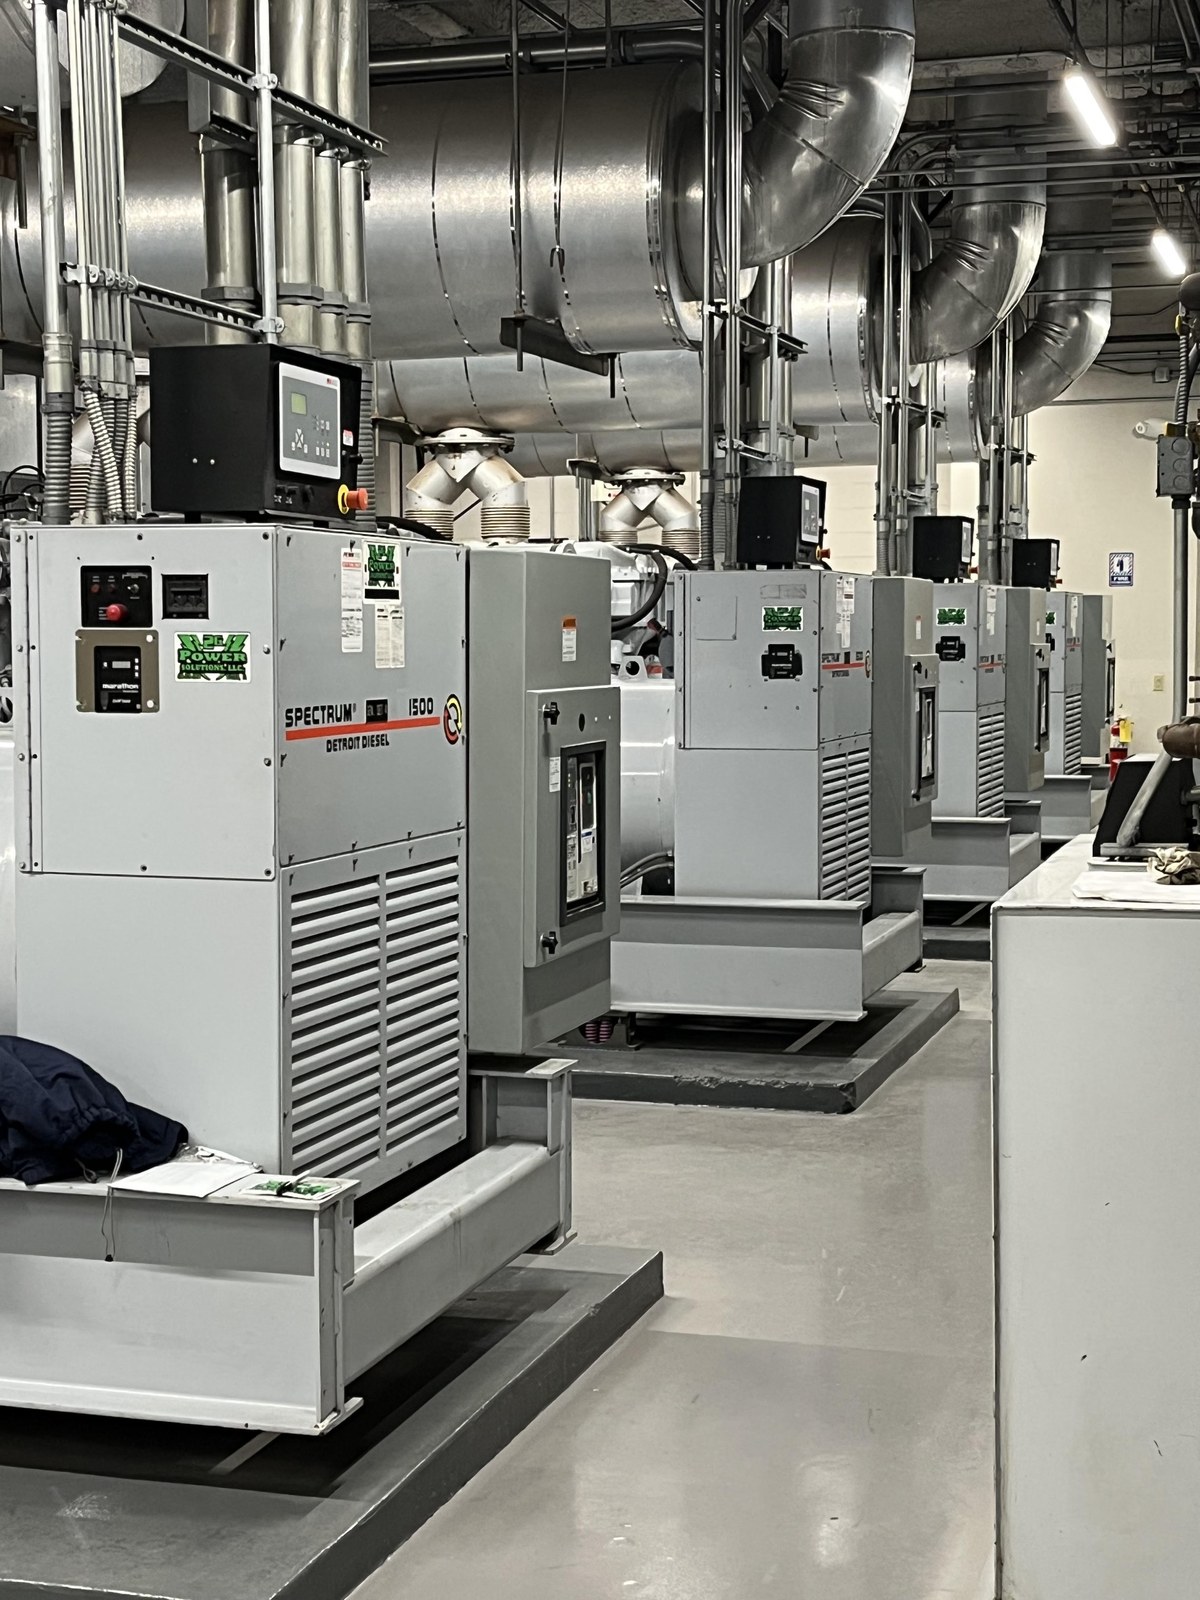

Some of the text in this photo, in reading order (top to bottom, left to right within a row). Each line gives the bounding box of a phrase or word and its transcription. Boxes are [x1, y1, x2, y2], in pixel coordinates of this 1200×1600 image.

[179, 650, 246, 662] POWER
[409, 697, 433, 716] 1500
[326, 733, 390, 752] DETROIT DIESEL
